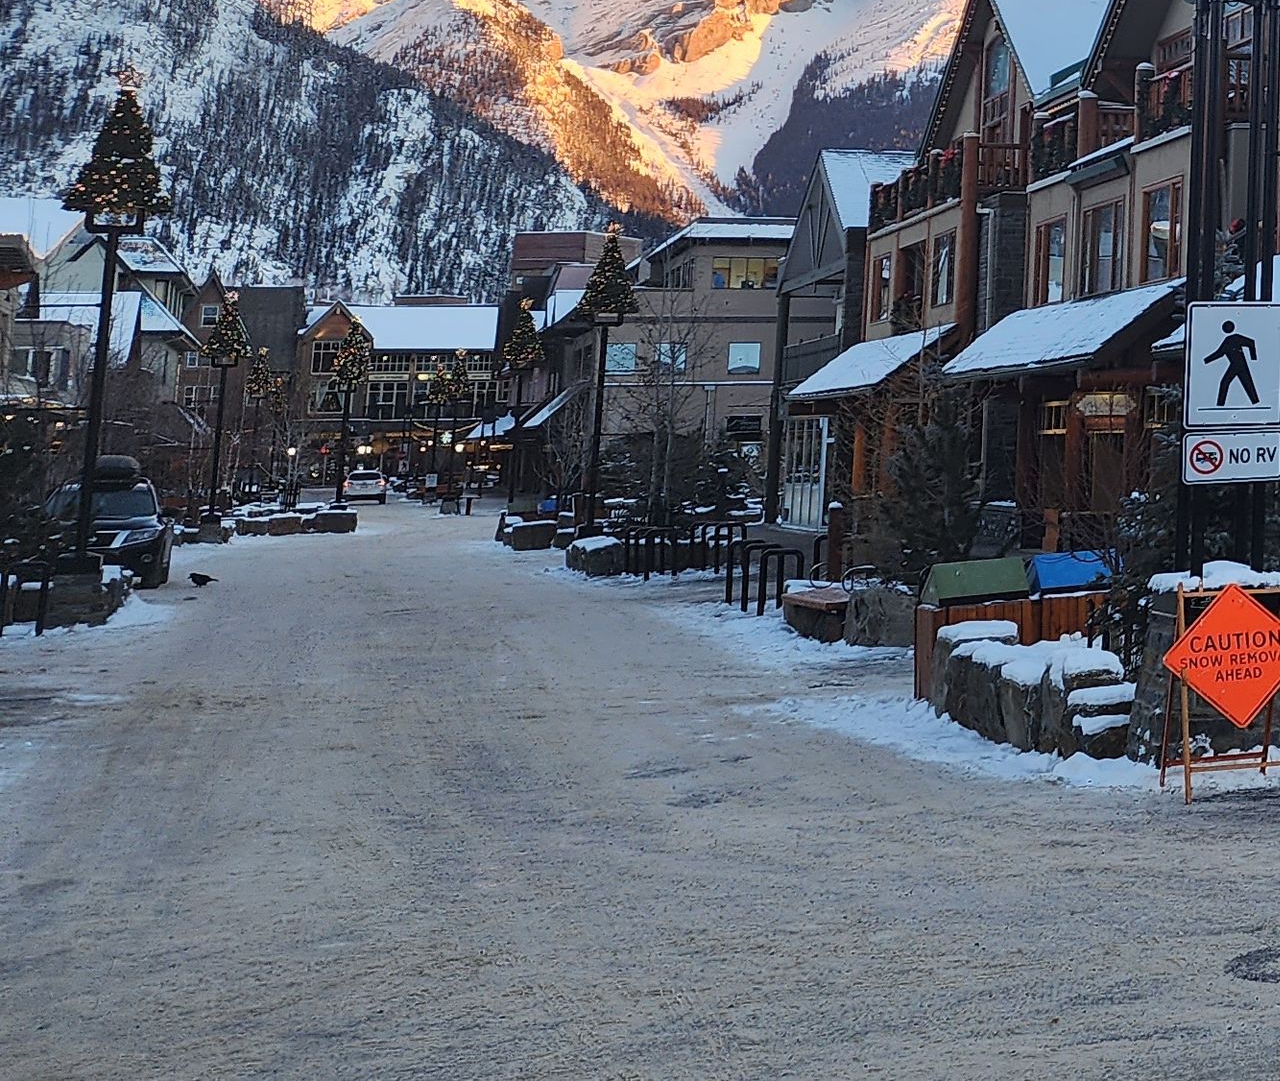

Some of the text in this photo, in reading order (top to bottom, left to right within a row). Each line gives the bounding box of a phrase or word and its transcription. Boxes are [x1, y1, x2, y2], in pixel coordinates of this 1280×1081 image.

[1228, 446, 1278, 465] NO RV
[1180, 654, 1223, 670] SNOW
[1215, 666, 1263, 683] AHEAD
